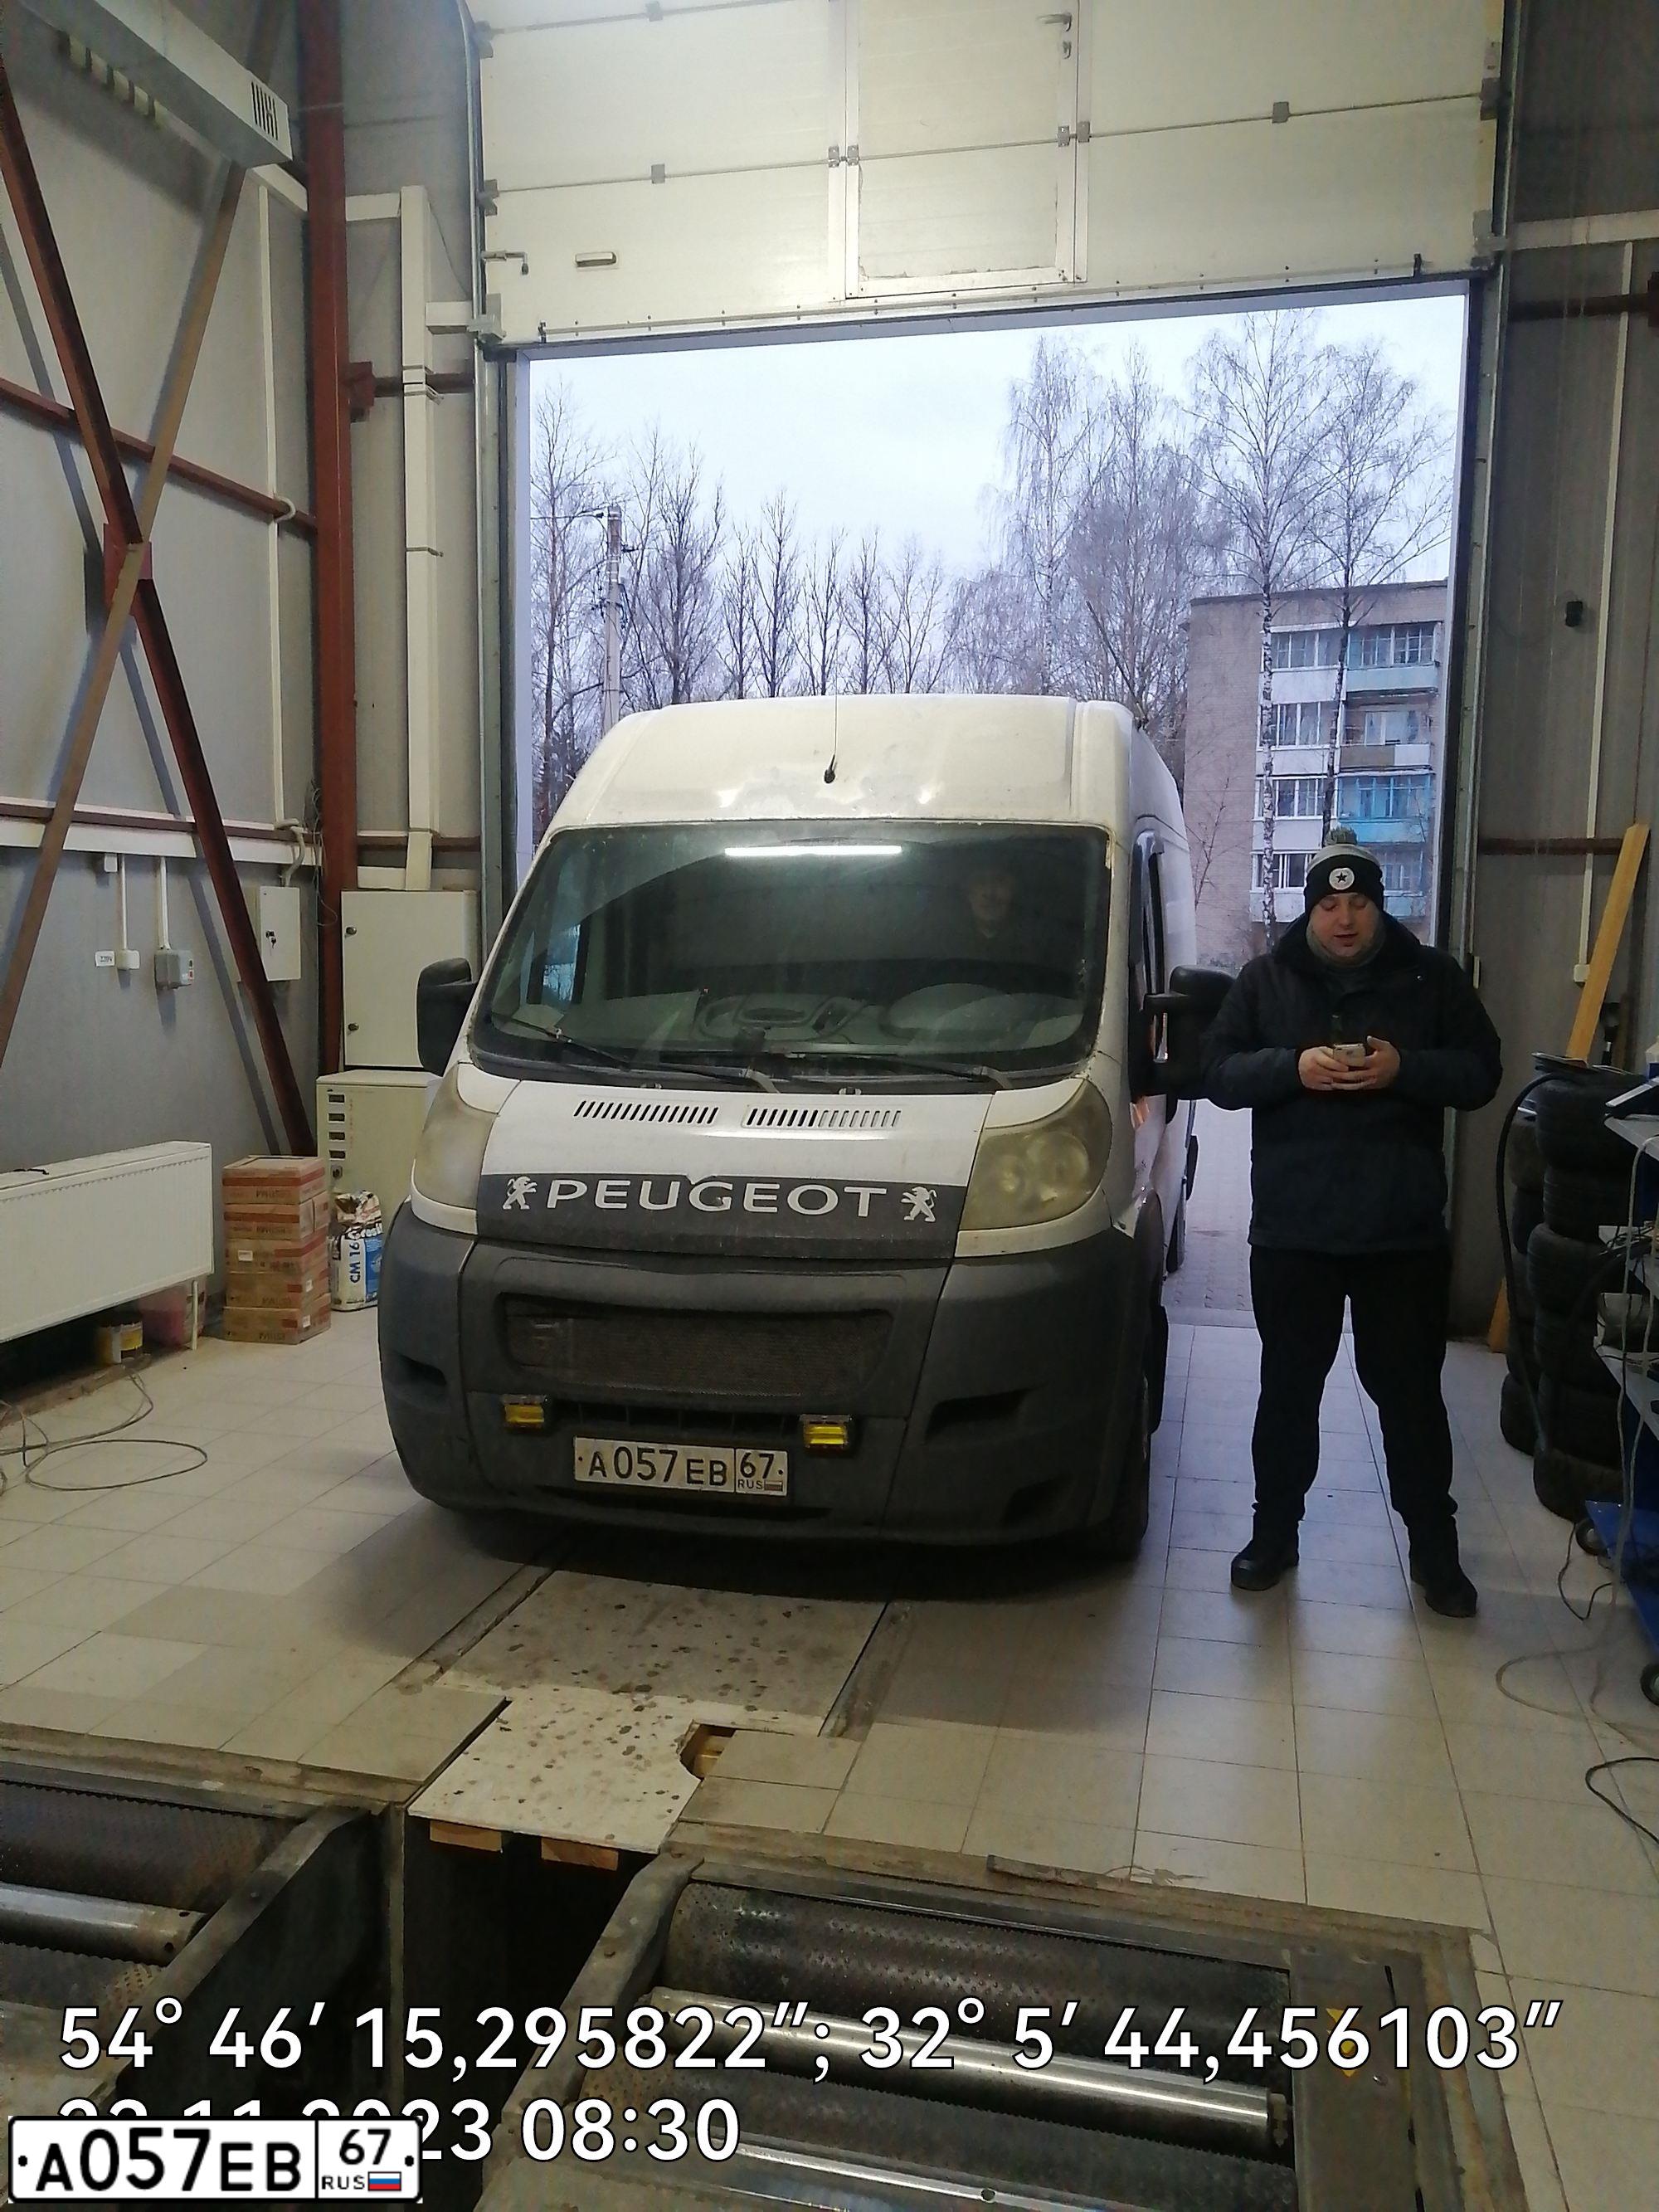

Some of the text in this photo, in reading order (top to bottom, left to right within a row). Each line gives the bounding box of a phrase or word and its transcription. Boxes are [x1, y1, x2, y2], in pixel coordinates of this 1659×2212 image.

[546, 1179, 888, 1218] PEUGEOT
[348, 1241, 361, 1284] CM 16
[739, 1451, 776, 1480] 67
[737, 1478, 764, 1491] RUS
